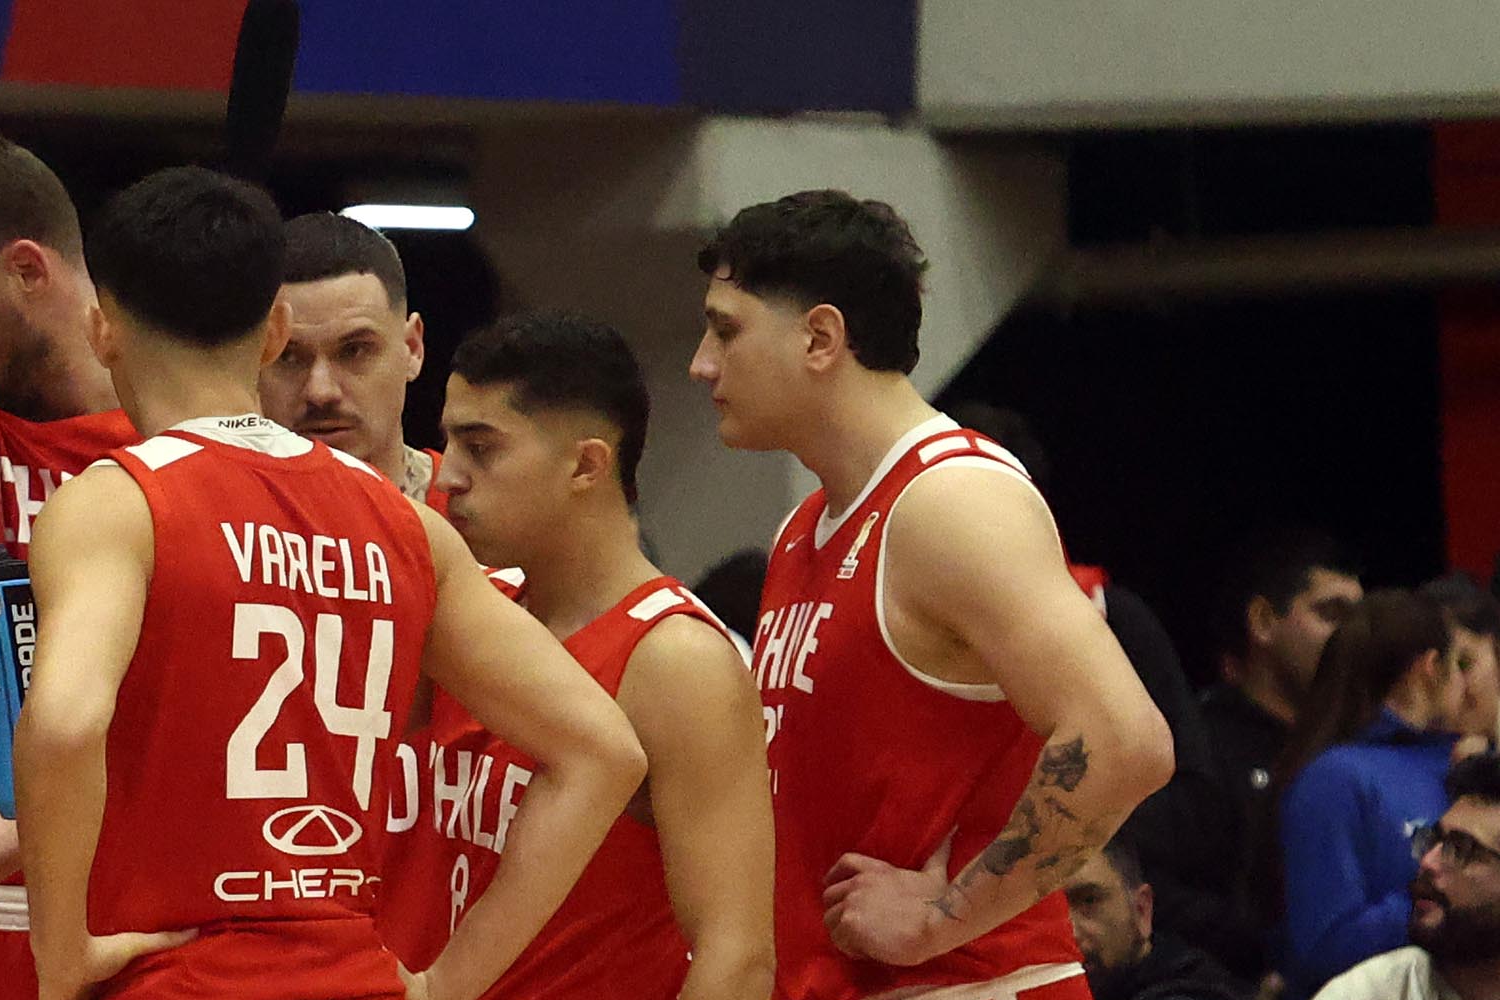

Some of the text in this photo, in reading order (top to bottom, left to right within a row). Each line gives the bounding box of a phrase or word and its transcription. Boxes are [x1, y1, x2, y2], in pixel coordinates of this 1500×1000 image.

[218, 417, 257, 428] NIKE
[220, 522, 392, 604] VARELA
[226, 603, 394, 811] 24
[214, 869, 381, 902] CHER
